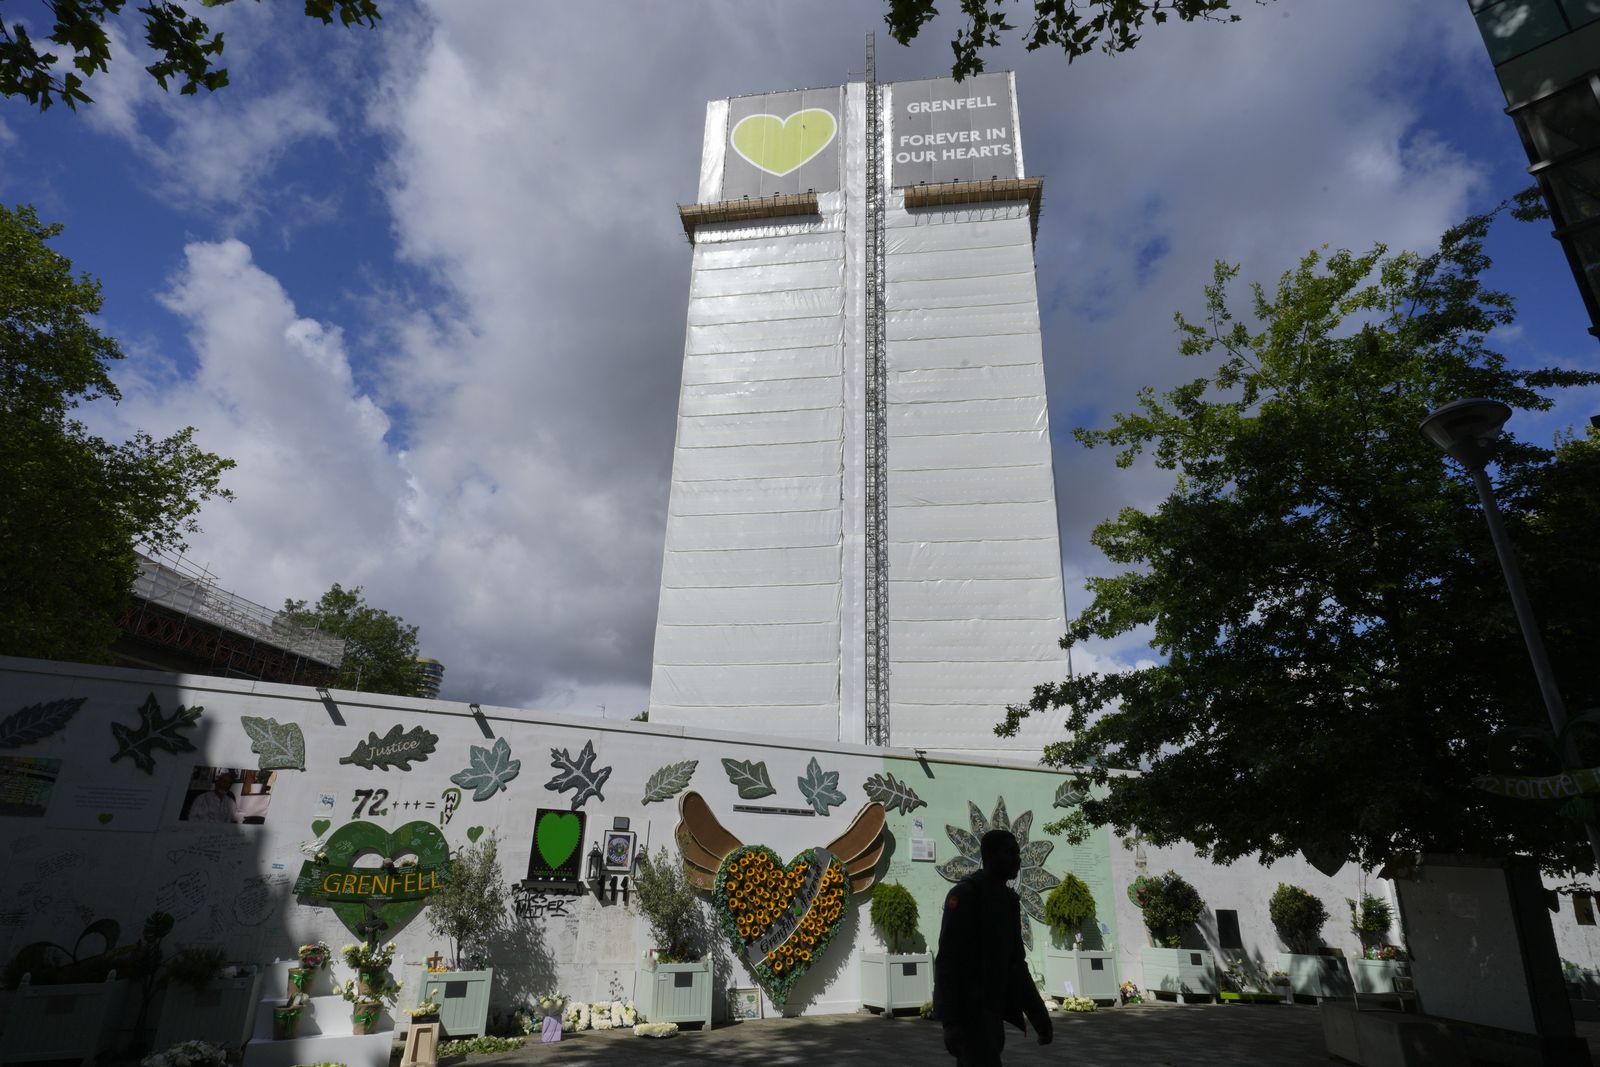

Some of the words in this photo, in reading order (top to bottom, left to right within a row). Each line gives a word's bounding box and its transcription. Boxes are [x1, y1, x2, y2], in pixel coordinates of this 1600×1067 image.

[907, 96, 997, 114] GRENFELL
[900, 131, 980, 147] FOREVER
[986, 127, 1007, 140] IN
[895, 150, 937, 164] OUR
[942, 143, 1012, 161] HEARTS
[366, 738, 420, 761] Justice
[352, 788, 388, 817] 72
[323, 870, 444, 896] GRENFELL
